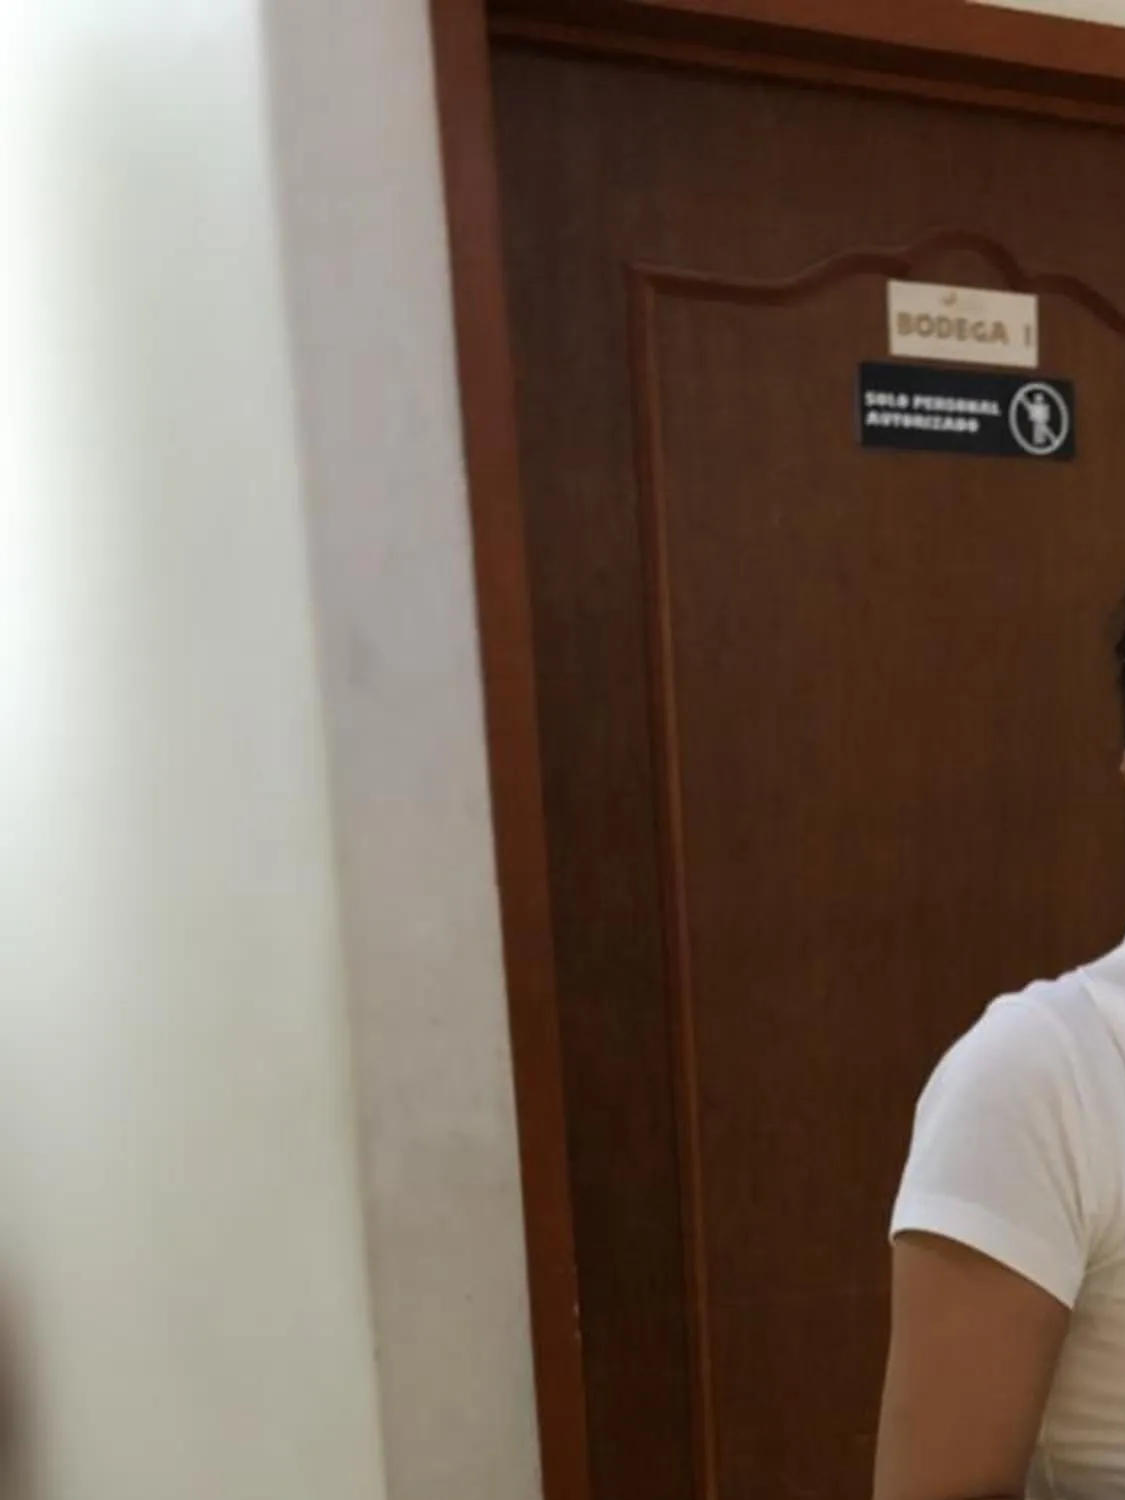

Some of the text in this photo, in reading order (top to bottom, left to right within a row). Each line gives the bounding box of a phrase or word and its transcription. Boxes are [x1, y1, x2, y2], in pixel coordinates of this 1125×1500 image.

[896, 312, 1010, 346] BODEGA
[864, 390, 1001, 417] SOLO PERSONAL
[865, 411, 980, 434] AUTORIZADO
